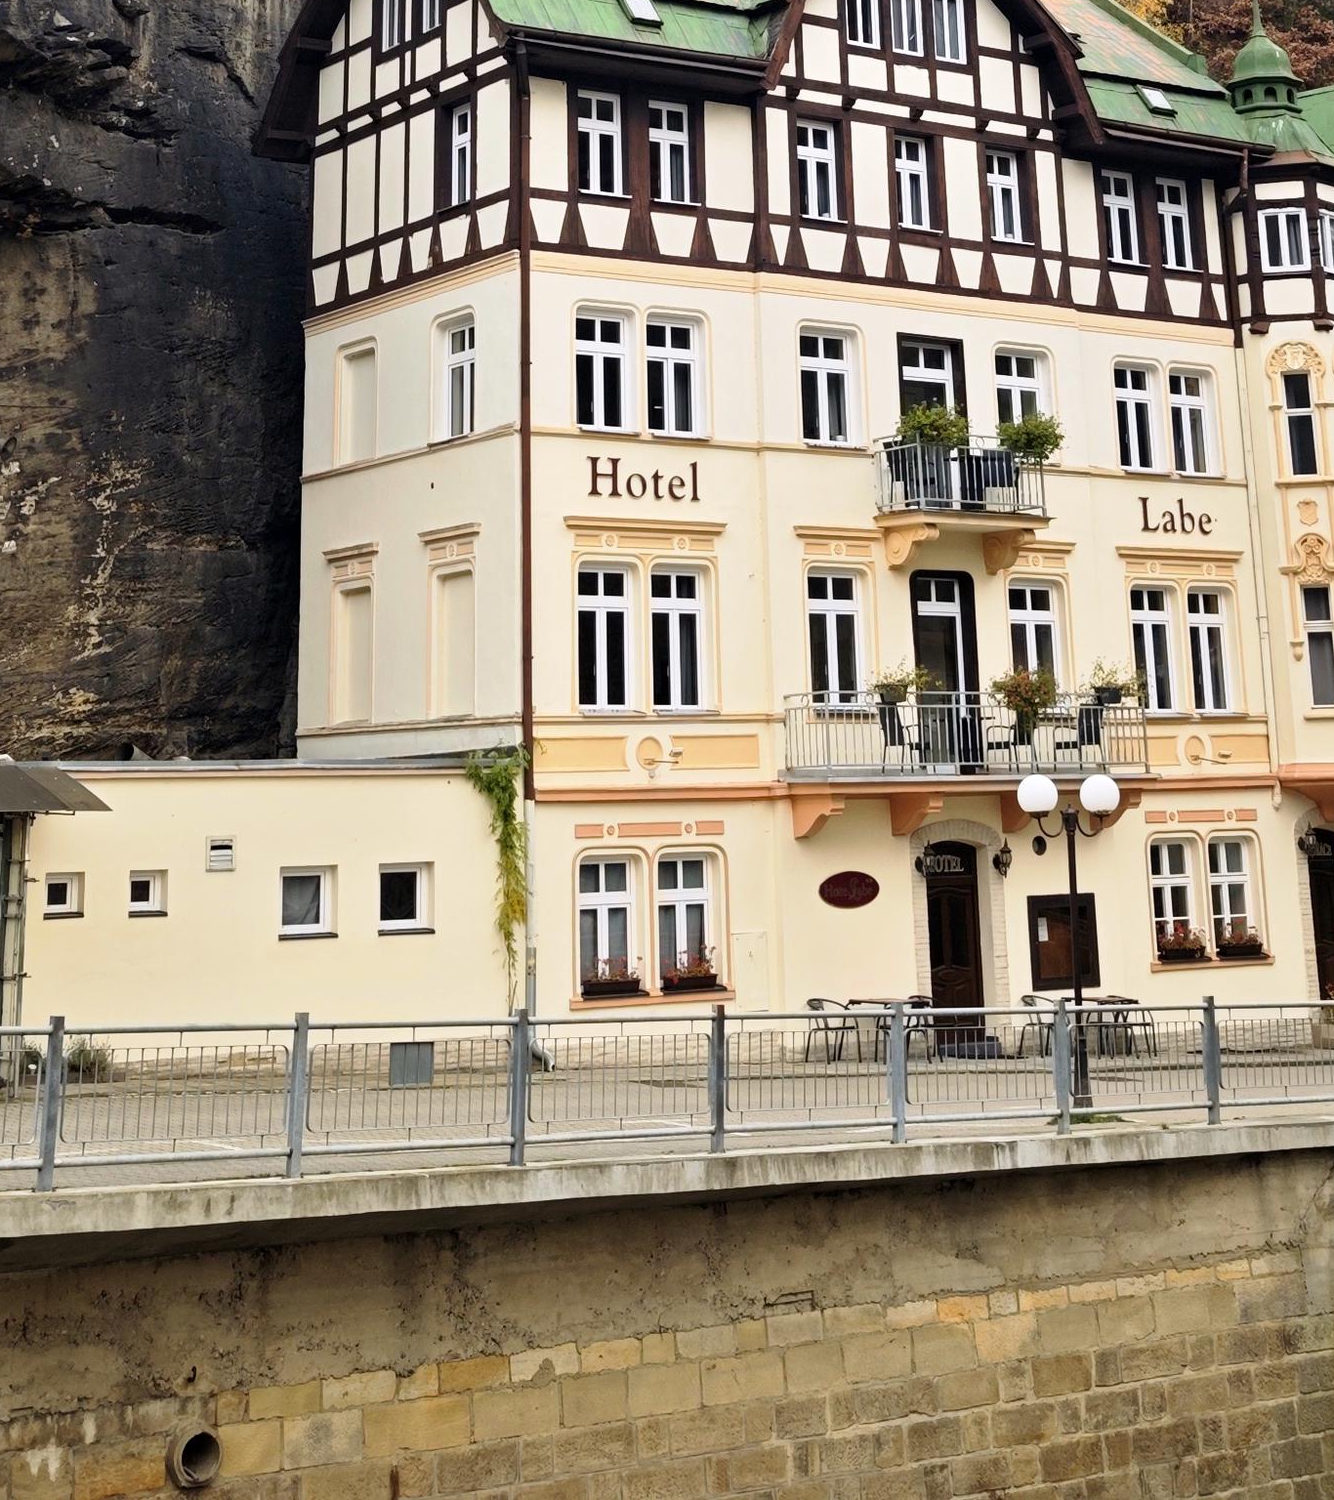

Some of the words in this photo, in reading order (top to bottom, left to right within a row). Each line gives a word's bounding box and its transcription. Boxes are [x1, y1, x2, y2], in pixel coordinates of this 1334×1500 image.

[586, 455, 701, 502] Hotel
[1137, 496, 1213, 536] Labe
[923, 854, 965, 873] OTEL
